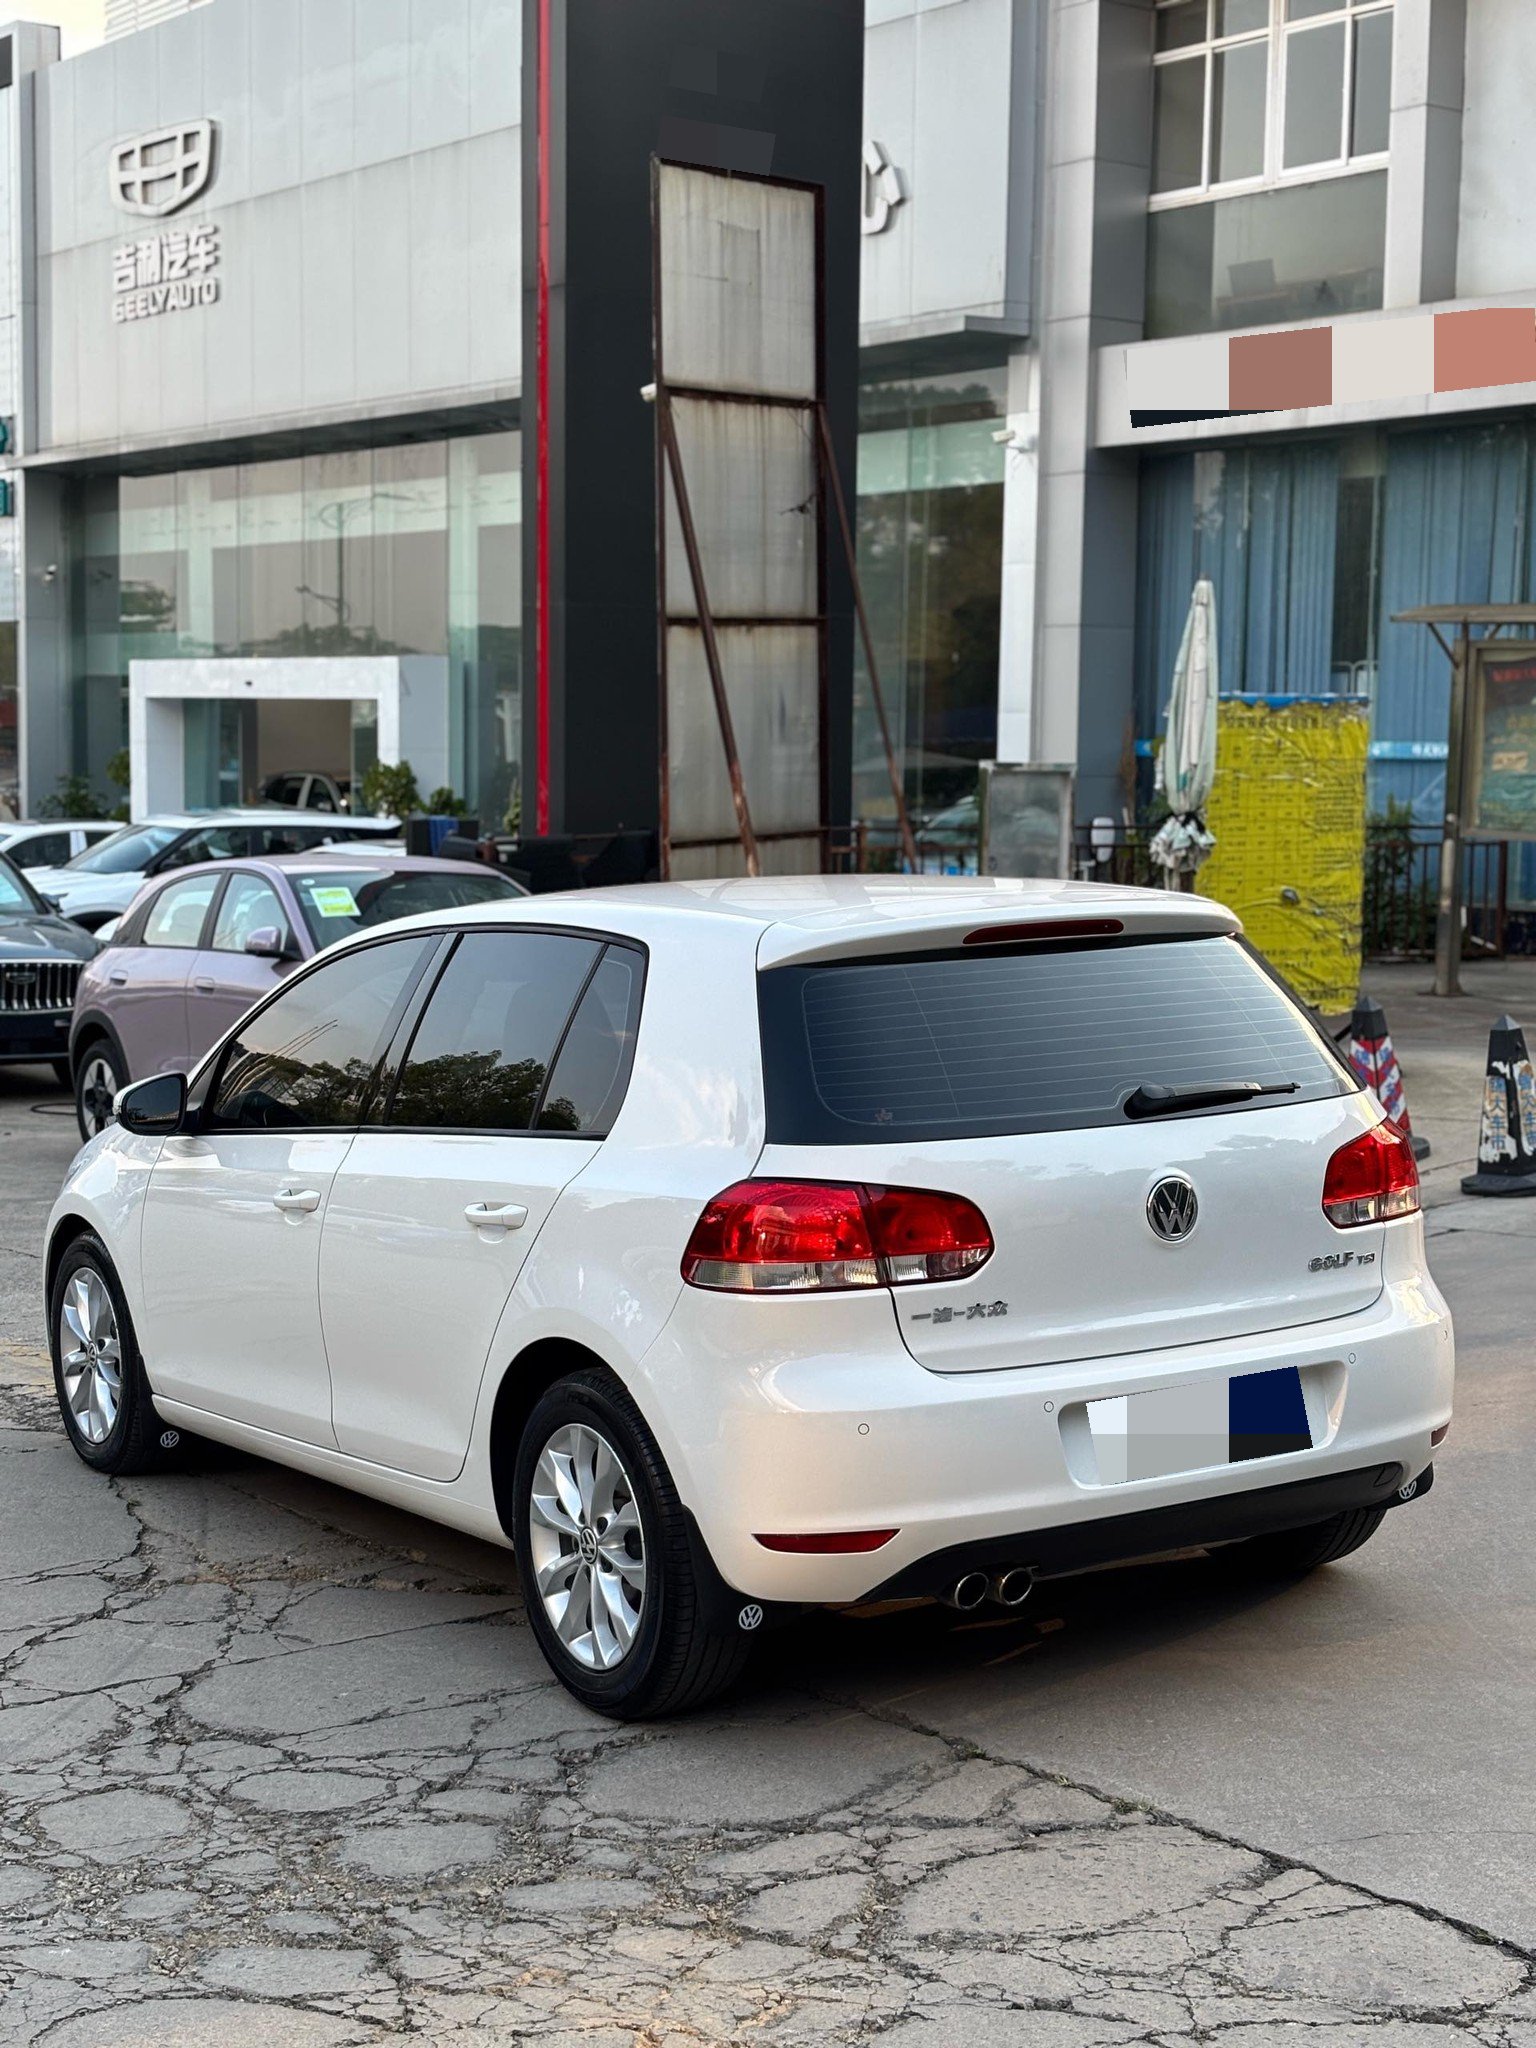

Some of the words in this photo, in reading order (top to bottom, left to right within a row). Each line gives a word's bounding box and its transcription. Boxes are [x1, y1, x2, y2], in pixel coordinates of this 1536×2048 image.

[113, 224, 219, 294] 吉利汽车
[1149, 1178, 1196, 1239] VW
[1308, 1251, 1355, 1272] GOLF
[1357, 1252, 1375, 1266] TSI
[739, 1604, 763, 1630] VW
